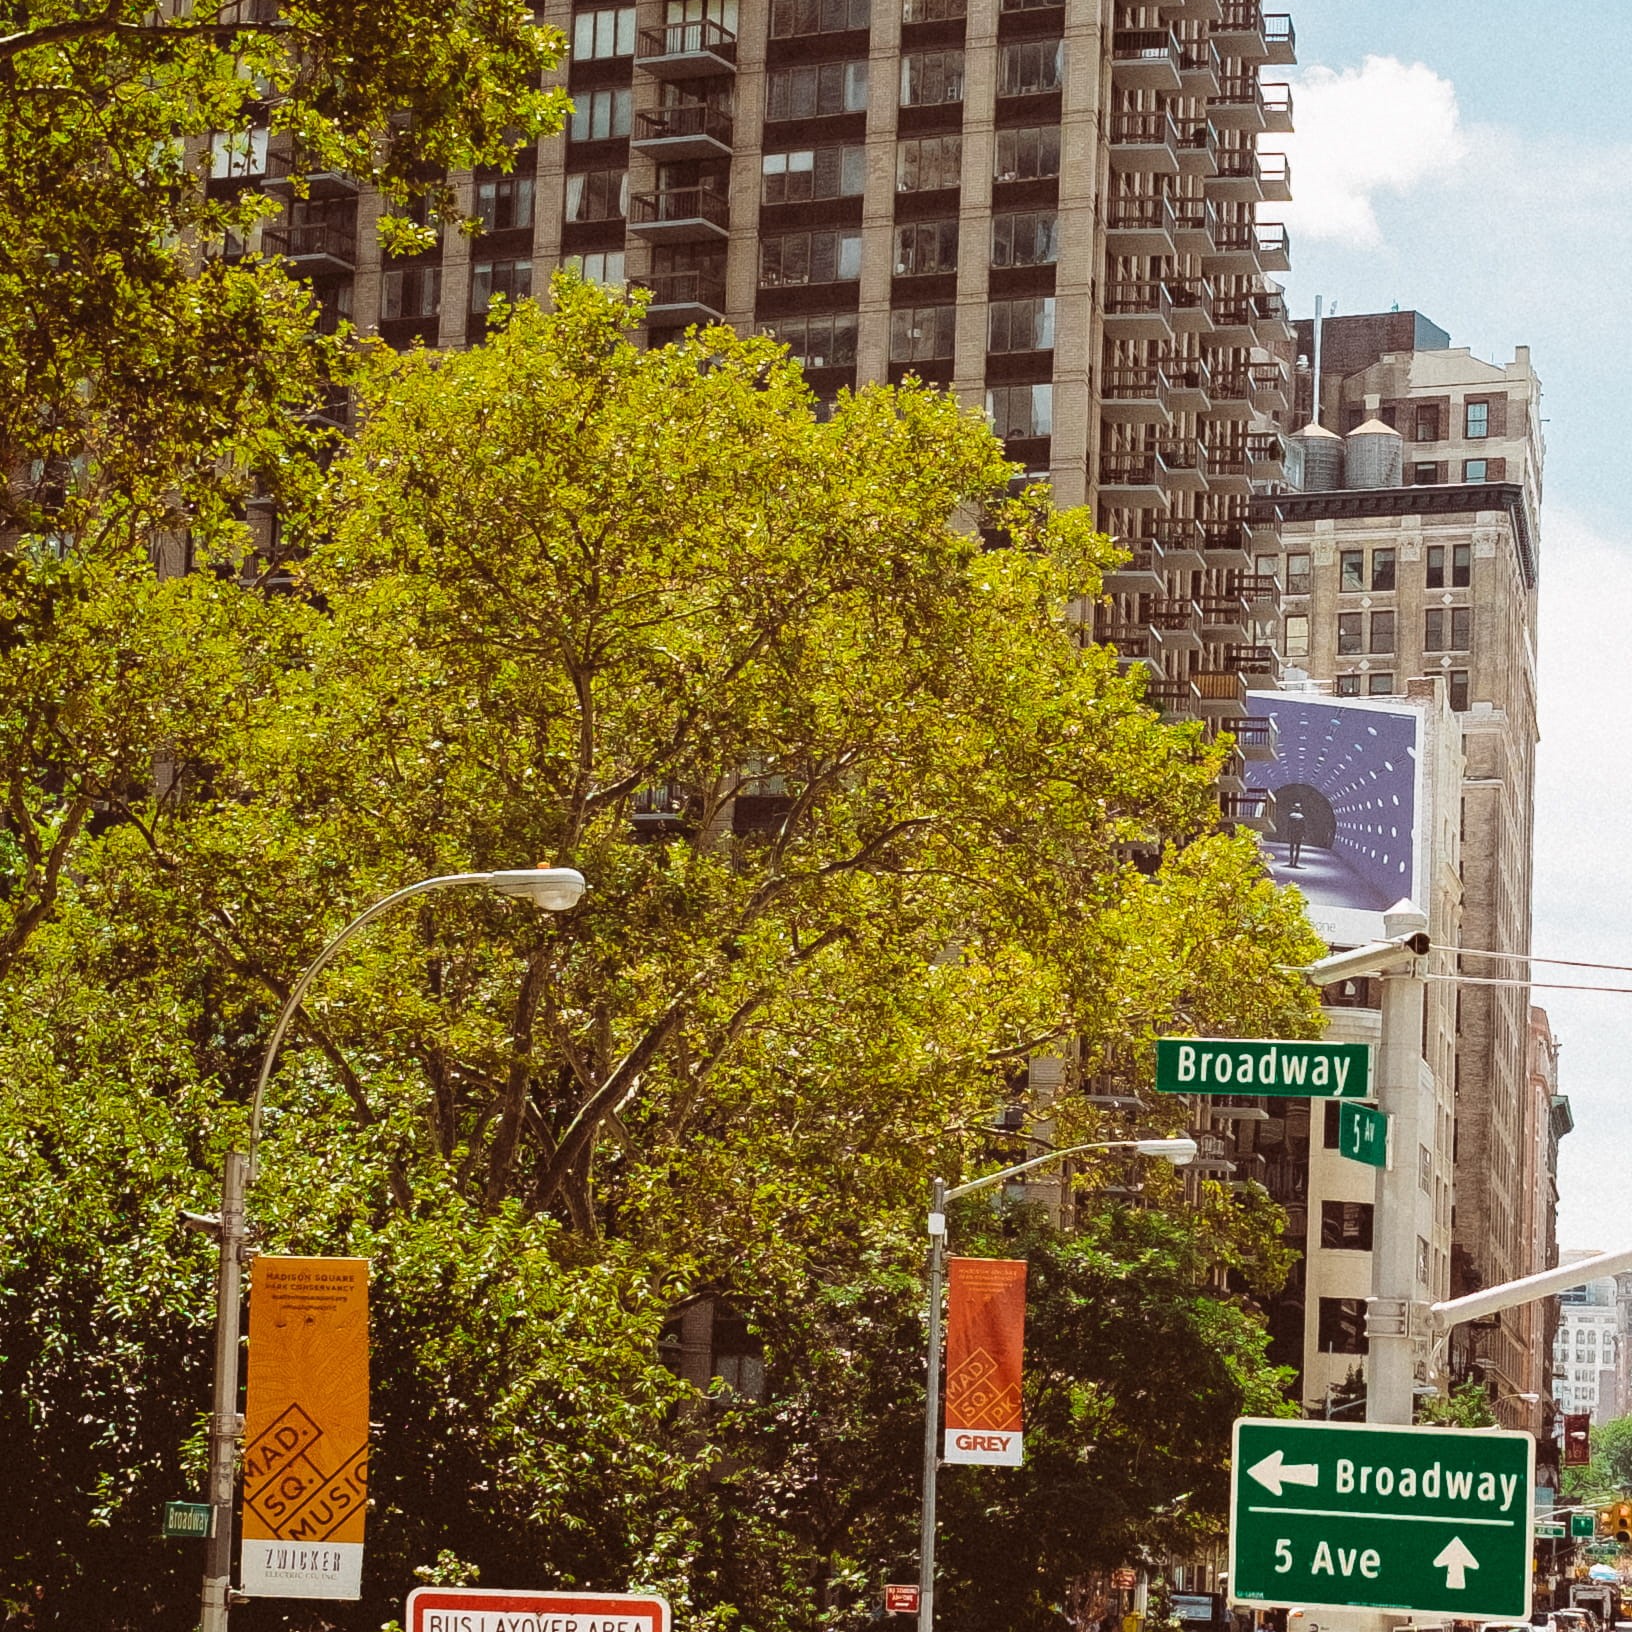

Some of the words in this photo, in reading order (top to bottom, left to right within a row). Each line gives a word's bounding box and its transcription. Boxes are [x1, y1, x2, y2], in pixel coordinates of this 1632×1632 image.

[1177, 1045, 1351, 1096] Broadway
[1352, 1114, 1361, 1154] 5
[315, 1274, 355, 1283] SQUARE
[946, 1360, 989, 1400] MAD.
[961, 1391, 994, 1417] SQ.
[243, 1426, 308, 1489] MAD.
[956, 1434, 1011, 1452] GREY
[264, 1476, 314, 1517] SQ.
[1336, 1459, 1518, 1512] Broadway
[168, 1507, 209, 1533] Broadway
[265, 1548, 341, 1572] ZWICKER
[1274, 1538, 1293, 1574] 5
[1311, 1541, 1381, 1579] Ave
